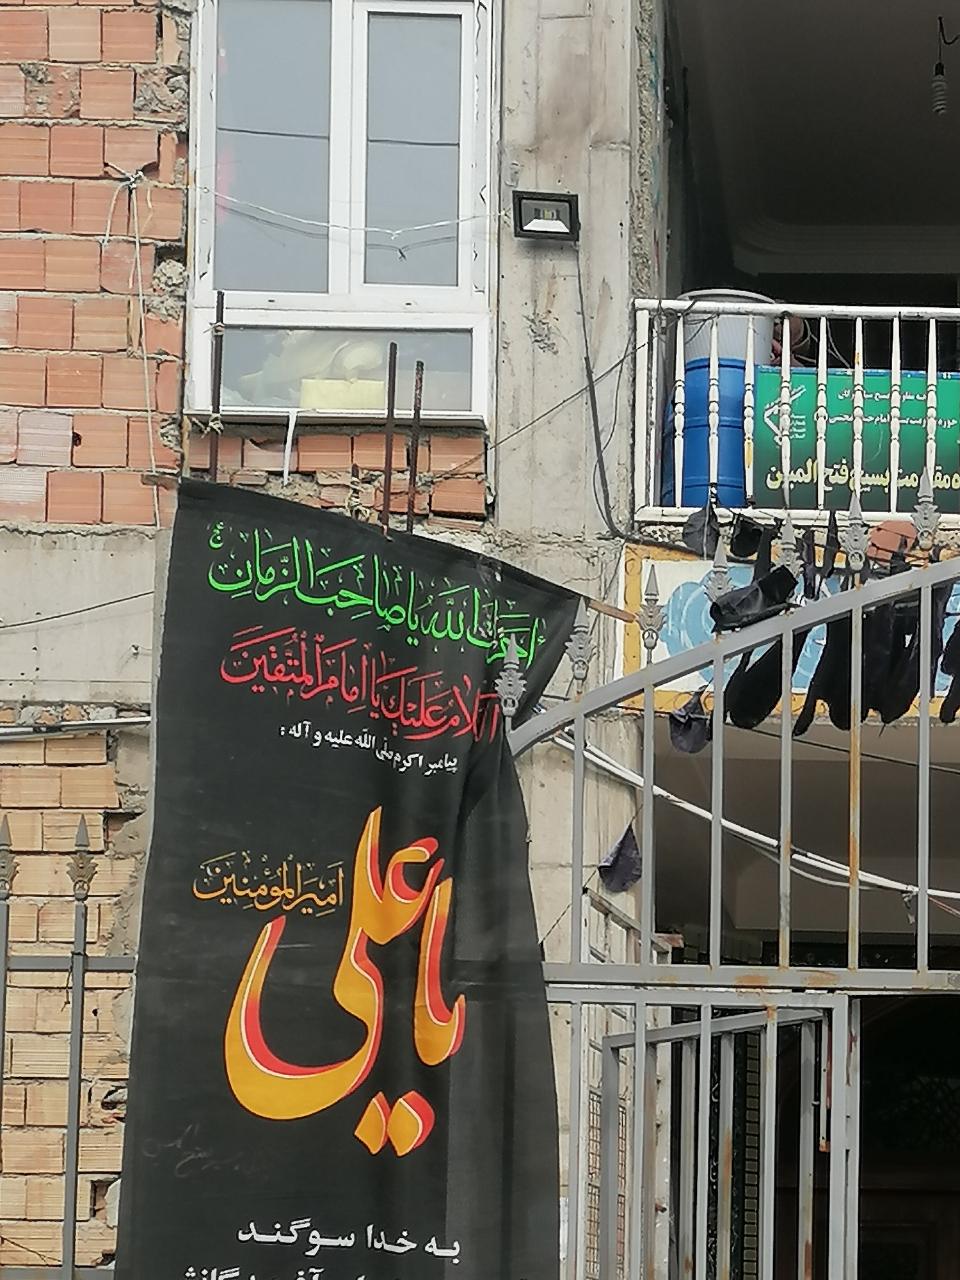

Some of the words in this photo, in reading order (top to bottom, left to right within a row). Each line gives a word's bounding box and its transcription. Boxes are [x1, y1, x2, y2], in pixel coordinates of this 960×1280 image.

[237, 1217, 357, 1257] سوگند
[366, 1223, 418, 1257] خدا
[424, 1230, 461, 1264] به
